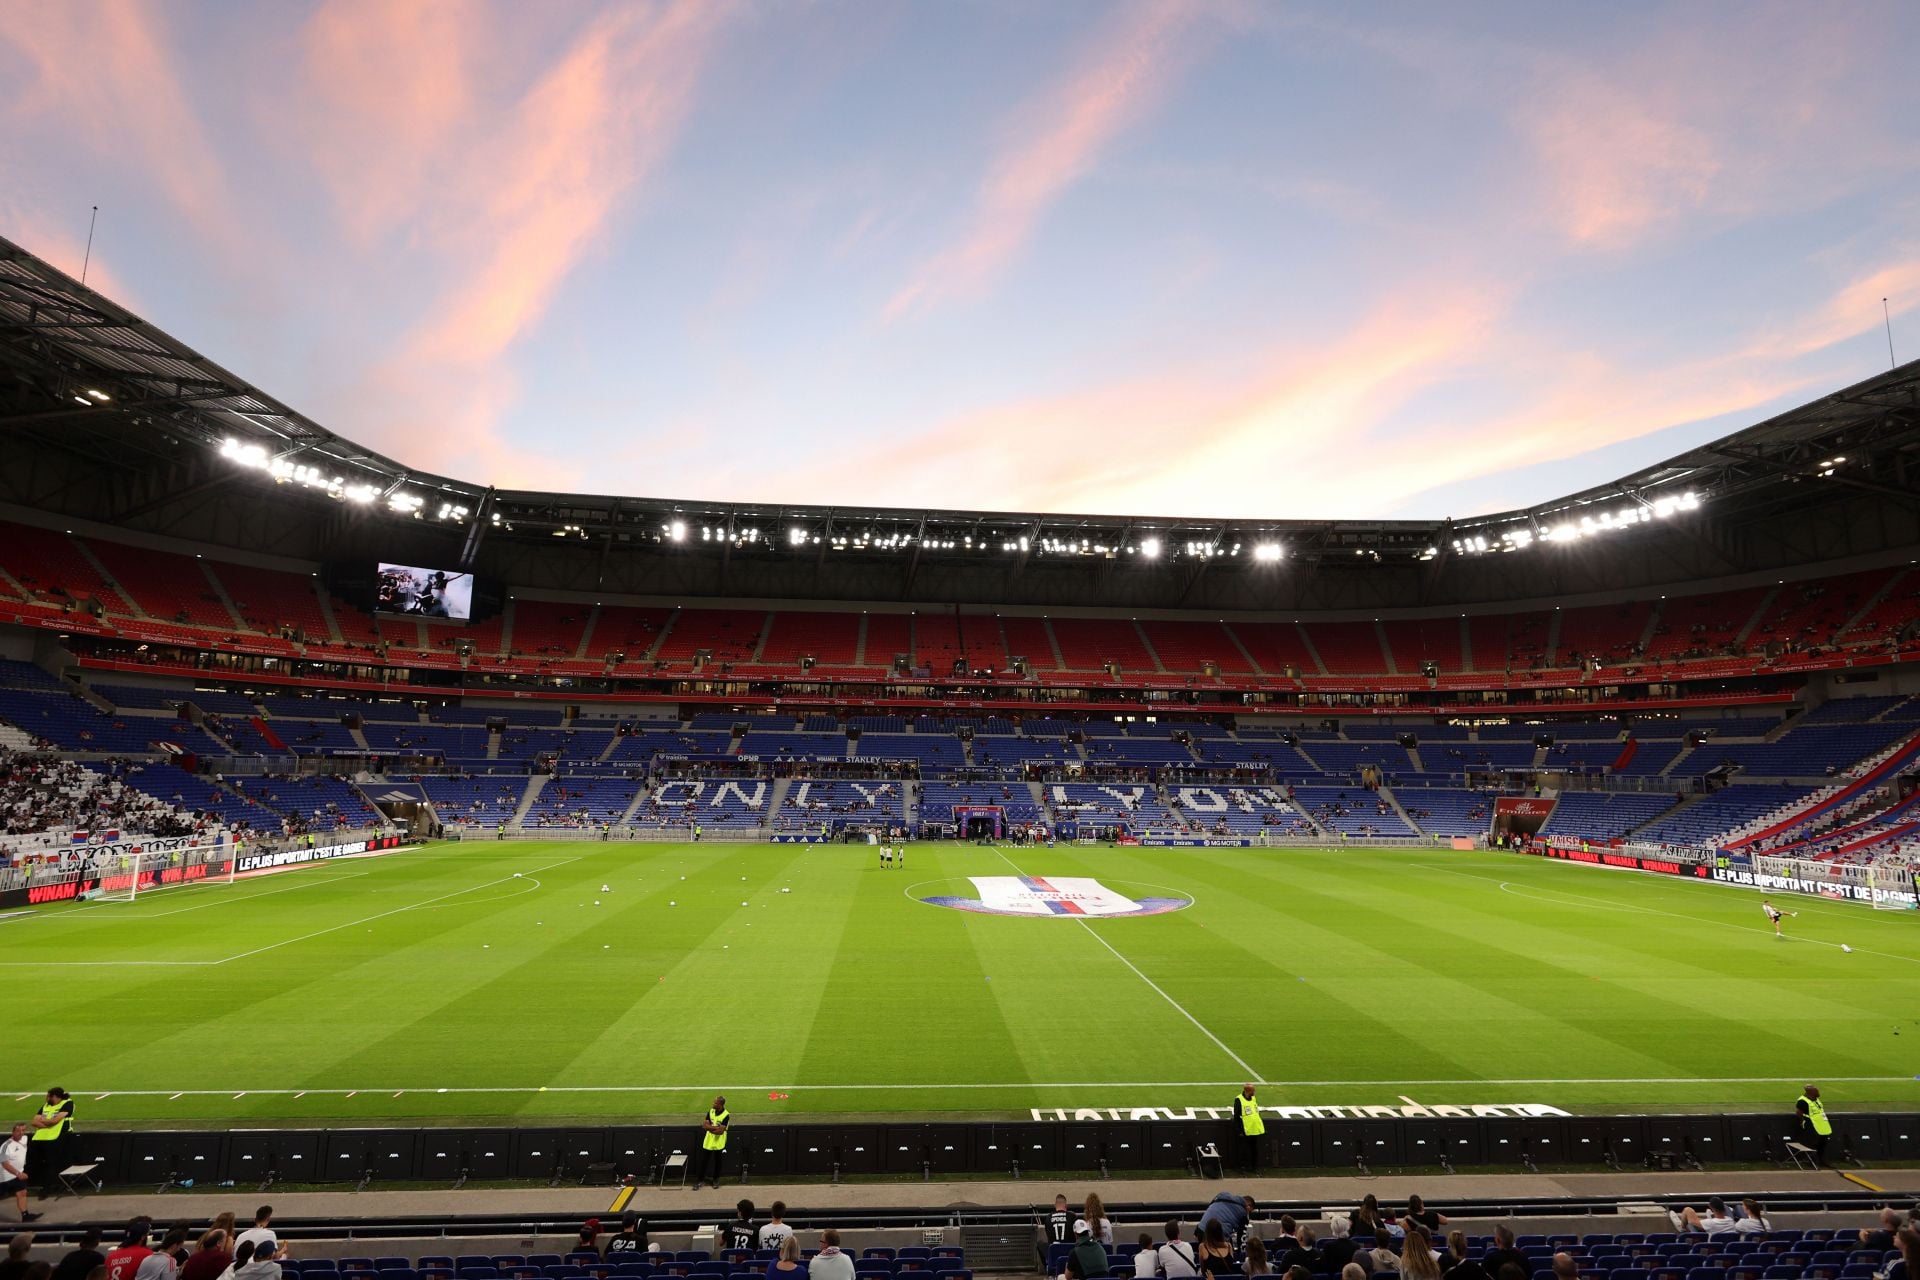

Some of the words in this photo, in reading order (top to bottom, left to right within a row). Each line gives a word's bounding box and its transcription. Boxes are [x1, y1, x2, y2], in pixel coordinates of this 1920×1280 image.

[41, 620, 74, 632] Groupama
[75, 626, 101, 634] STADIUM
[141, 634, 172, 643] Groupama
[173, 638, 197, 646] STADIUM
[234, 645, 263, 654] Groupama
[1773, 665, 1802, 673] Groupama
[846, 756, 881, 764] STANLEY
[1499, 807, 1547, 816] Emirates
[239, 857, 252, 871] LE
[251, 854, 273, 869] PLUS
[273, 848, 315, 866] IMPORTANT
[314, 845, 335, 860] C'EST
[1567, 849, 1600, 863] WINAMAX
[1602, 853, 1638, 868] WINAMAX
[1641, 858, 1680, 875] WINAMAX
[28, 880, 93, 904] WINAMX
[1713, 868, 1727, 881] LE
[1726, 870, 1754, 885] PLUS
[1753, 873, 1815, 893] IMPORTANT
[1816, 881, 1852, 898] C'EST
[1853, 885, 1872, 901] DE
[1873, 888, 1920, 904] GAGNE
[1053, 1223, 1066, 1241] 17
[734, 1234, 749, 1249] 13
[111, 1266, 122, 1280] 8
